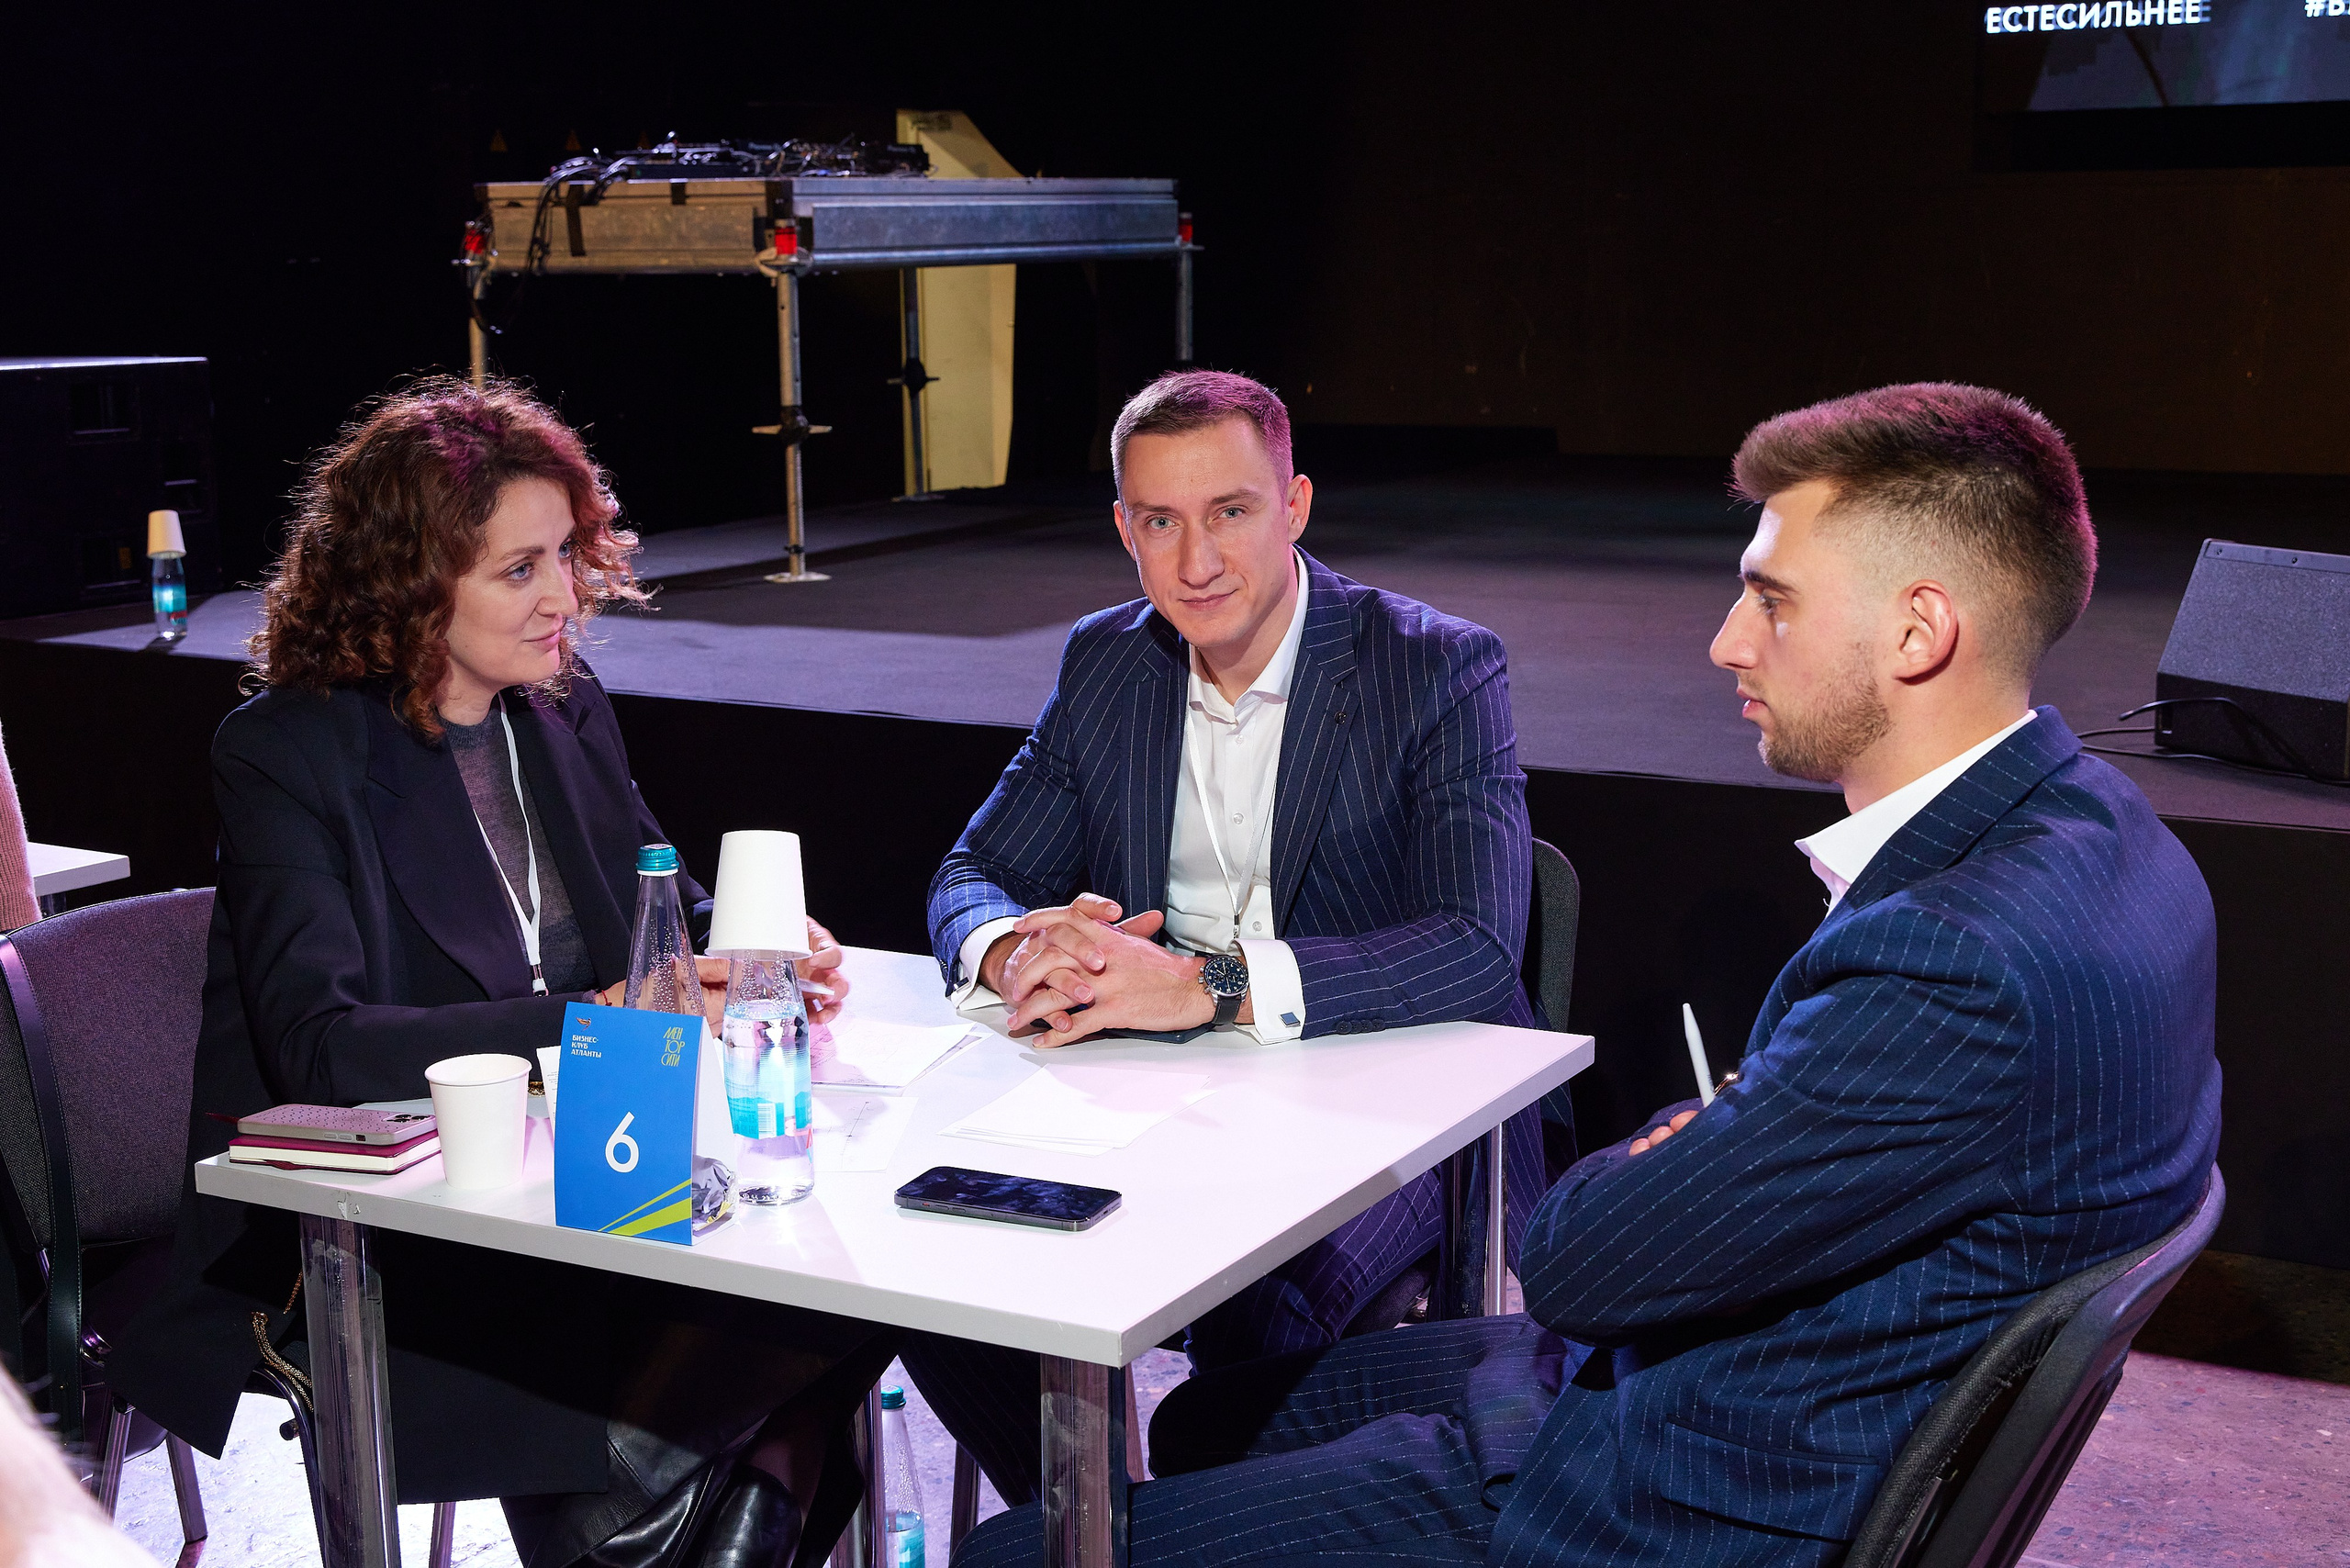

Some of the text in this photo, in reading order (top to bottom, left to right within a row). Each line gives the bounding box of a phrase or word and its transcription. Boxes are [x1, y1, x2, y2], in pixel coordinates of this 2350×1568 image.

[1986, 0, 2202, 34] ЕСТЕСИЛЬНЕЕ
[572, 1034, 599, 1044] БИЗНЕС-
[663, 1026, 684, 1040] МЕН
[571, 1041, 588, 1049] КЛУБ
[665, 1039, 686, 1054] ТОР
[570, 1048, 602, 1058] АТЛАНТЫ
[661, 1052, 680, 1067] СИТИ
[605, 1111, 640, 1174] 6
